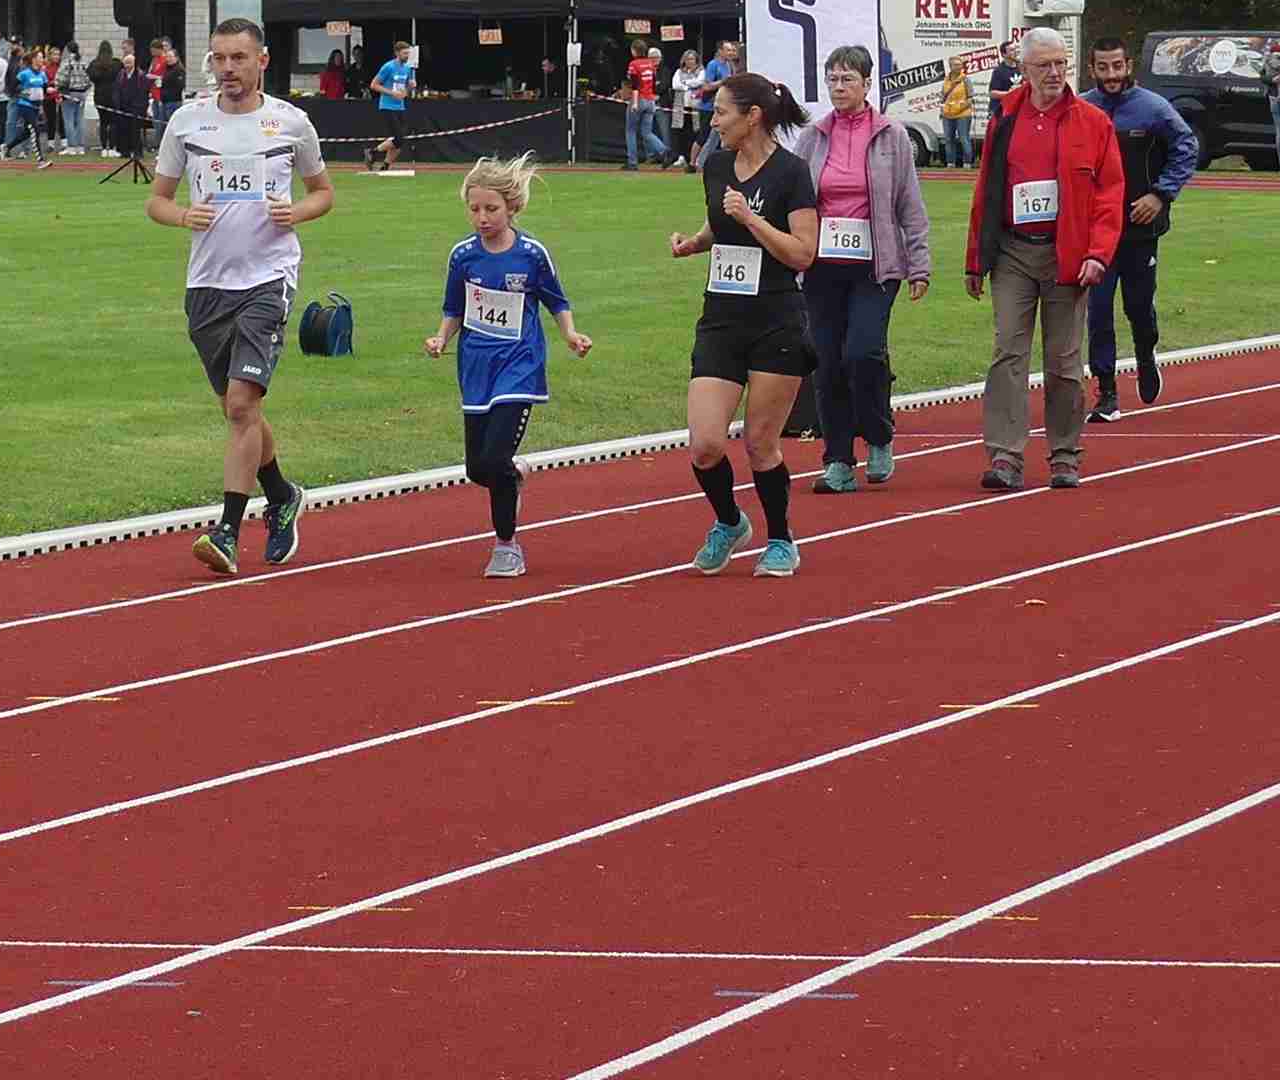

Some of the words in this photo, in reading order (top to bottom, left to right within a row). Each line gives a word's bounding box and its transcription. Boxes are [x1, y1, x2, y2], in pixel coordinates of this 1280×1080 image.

[1011, 27, 1031, 42] RE
[965, 60, 980, 74] 22
[883, 63, 939, 91] INOTHEK
[216, 175, 251, 192] 145
[1024, 197, 1051, 213] 167
[832, 232, 861, 249] 168
[717, 264, 746, 281] 146
[477, 305, 508, 327] 144
